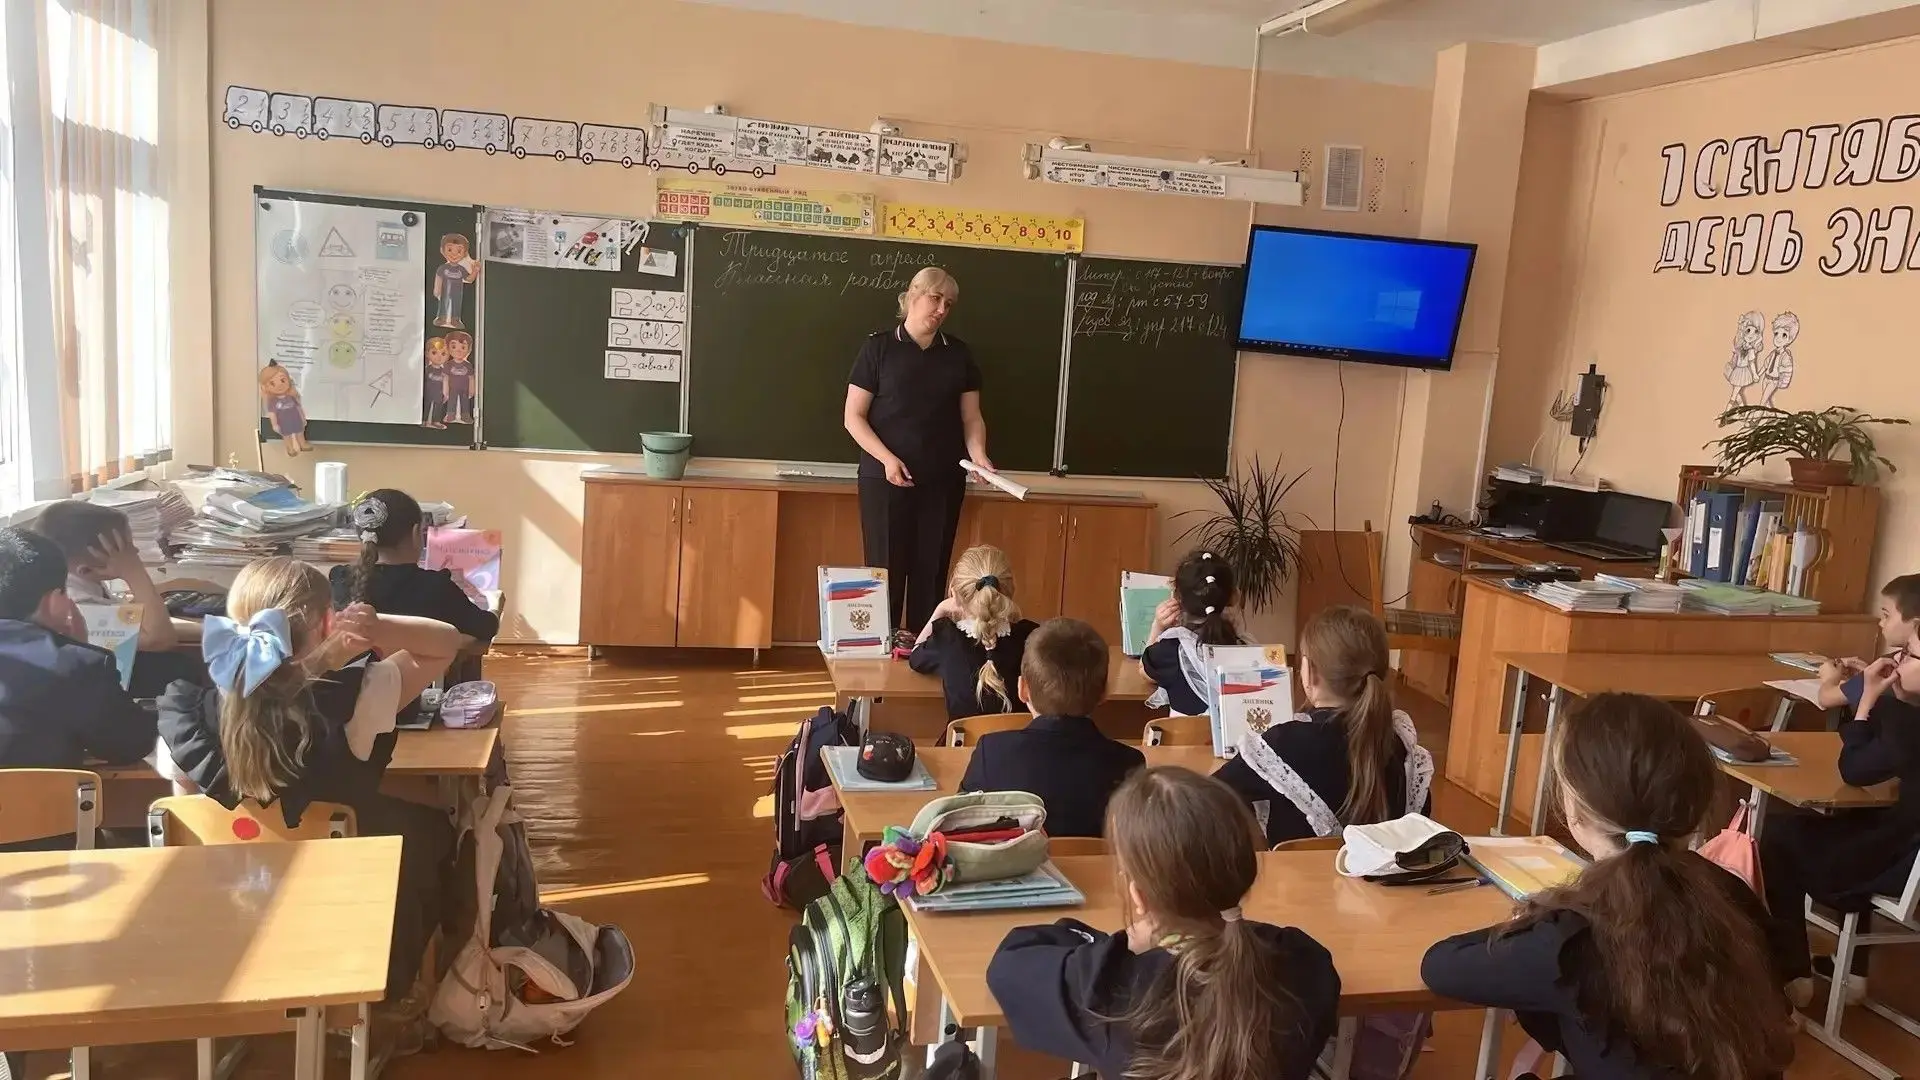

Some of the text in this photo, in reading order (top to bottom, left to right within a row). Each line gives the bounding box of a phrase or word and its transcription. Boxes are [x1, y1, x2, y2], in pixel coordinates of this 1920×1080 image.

[233, 94, 248, 114] 2
[278, 102, 291, 120] 3
[584, 132, 595, 150] 8
[680, 129, 716, 138] НАРЕЧИЕ
[1108, 166, 1158, 175] ЧИСЛИТЕЛЬНОЕ
[1180, 172, 1208, 180] ПРЕДЛОГ
[1660, 142, 1686, 206] 1
[1117, 181, 1151, 189] КОТОРЫЙ?
[890, 216, 1072, 240] 1 2 3 4 5 6 7 8 9 10
[1654, 206, 1920, 277] ДЕНЬ ЗН
[720, 232, 849, 273] Тридцатое
[714, 261, 908, 296] Классная работ
[1242, 702, 1273, 712] ДНЕВНИК
